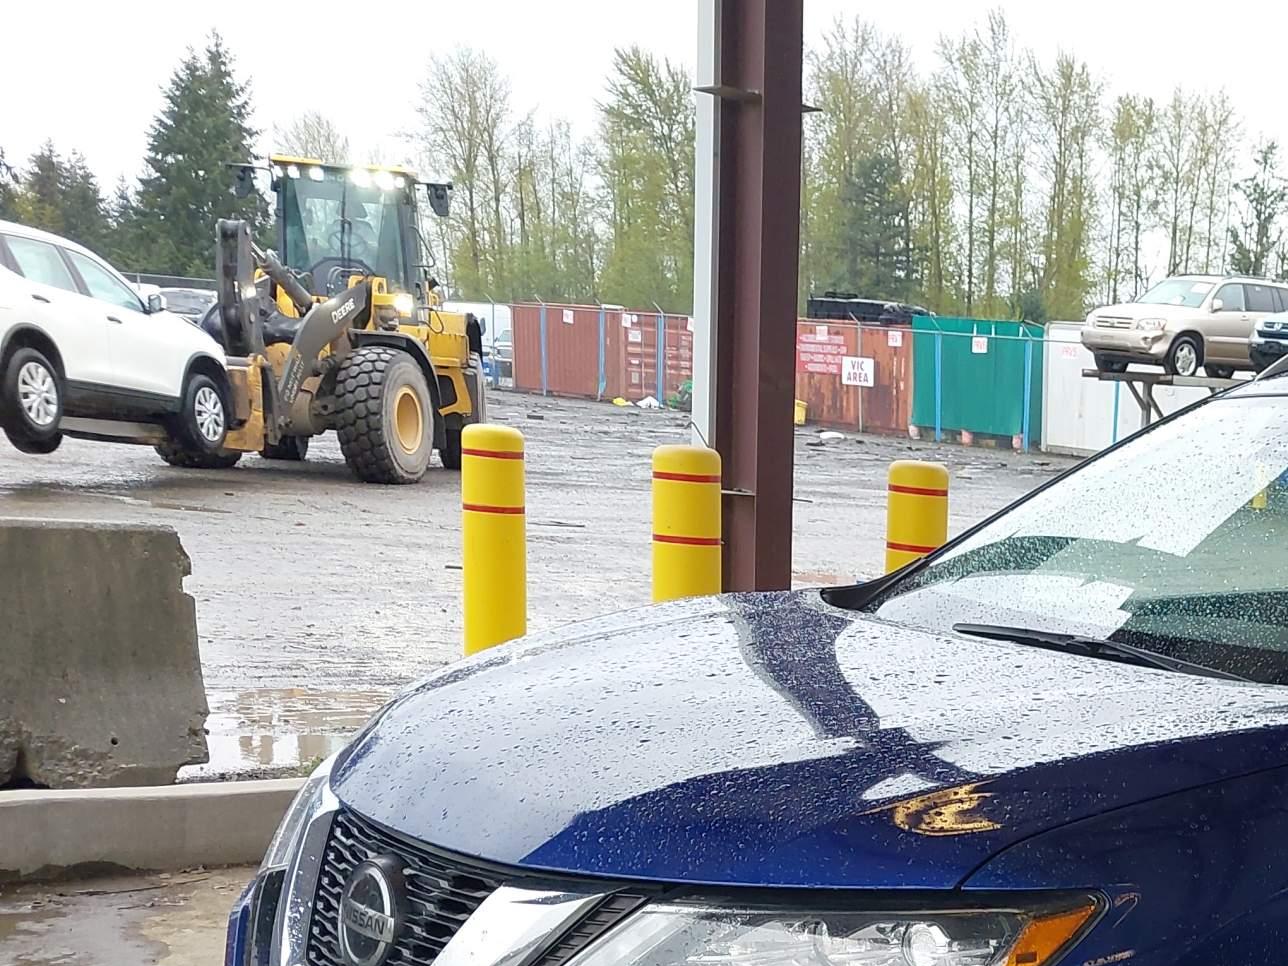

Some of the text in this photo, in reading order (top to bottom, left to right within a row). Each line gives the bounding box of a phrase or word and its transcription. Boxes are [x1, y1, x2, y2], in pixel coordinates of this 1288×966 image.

[331, 298, 355, 324] DEERE
[851, 360, 865, 372] VIC
[846, 372, 869, 383] AREA
